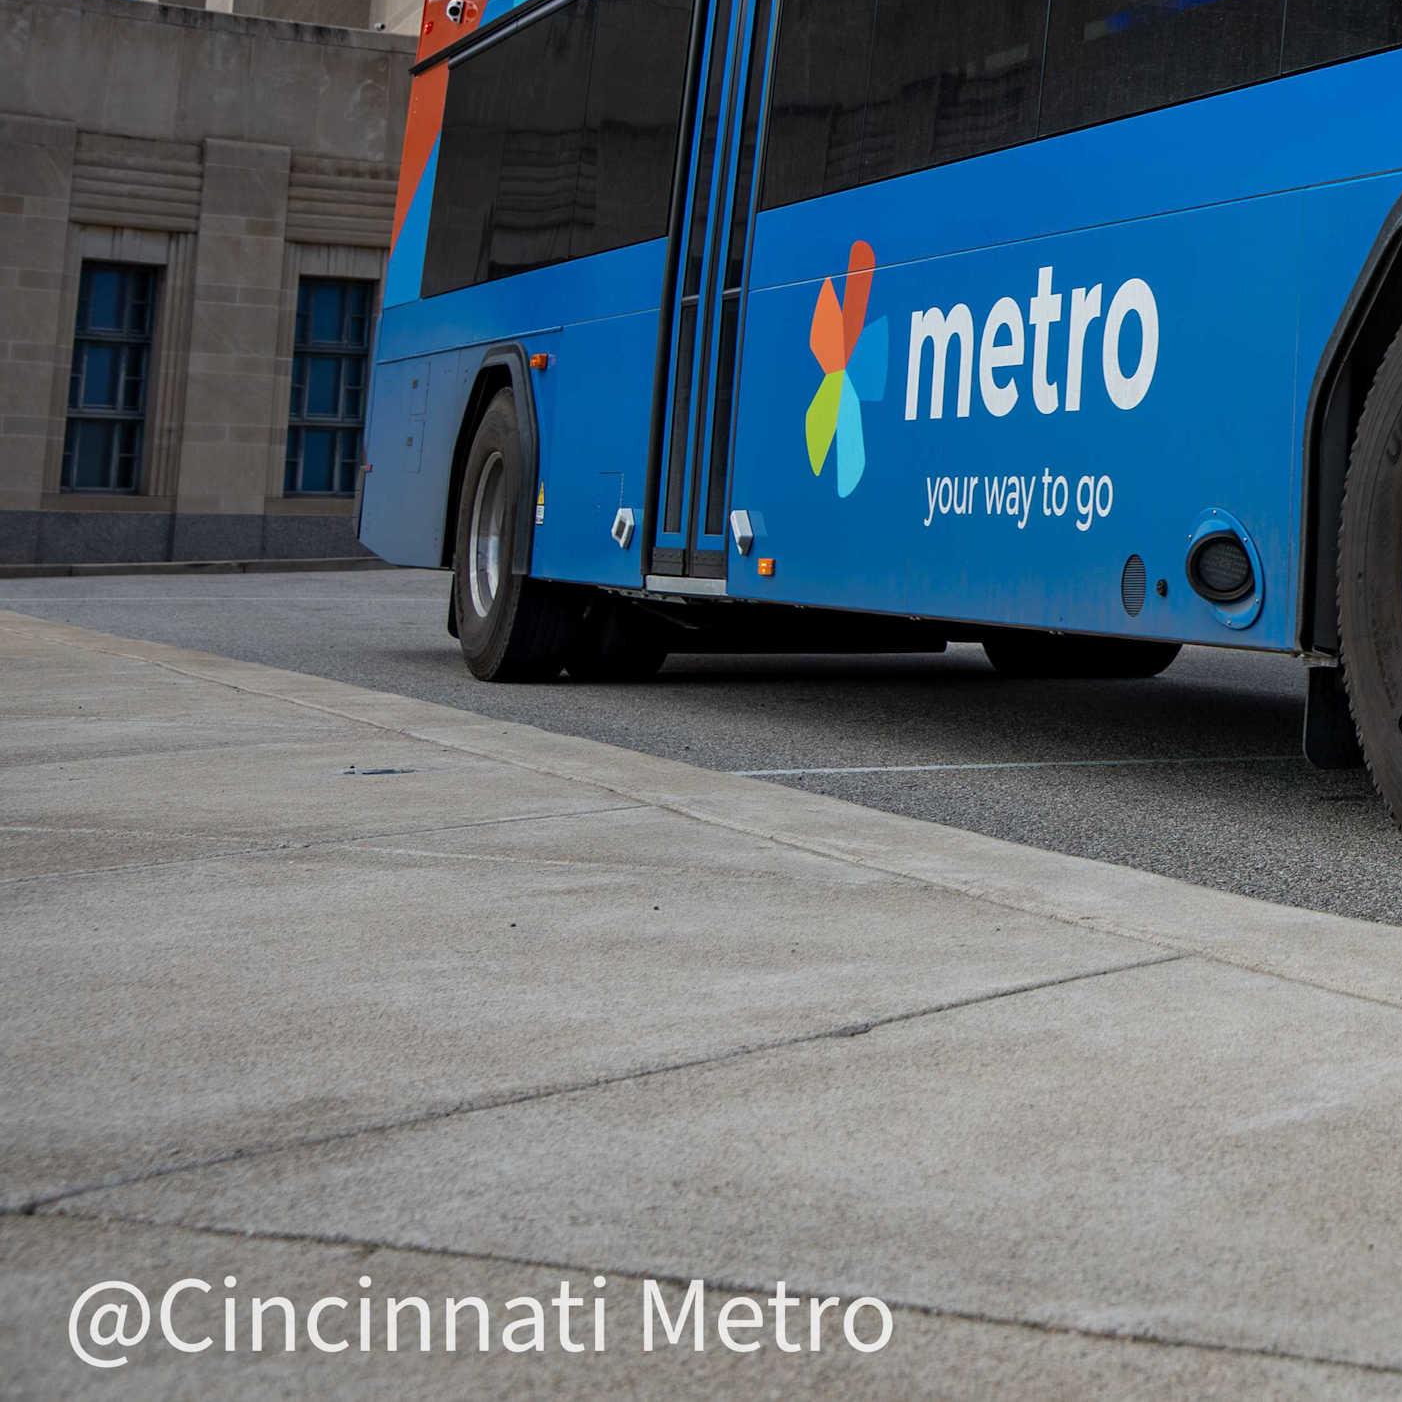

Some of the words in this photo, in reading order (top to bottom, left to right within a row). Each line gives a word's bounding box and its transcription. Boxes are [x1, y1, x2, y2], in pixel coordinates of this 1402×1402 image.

[904, 266, 1159, 421] metro
[923, 476, 979, 528] your
[984, 476, 1037, 531] way
[1042, 467, 1069, 517] to
[1076, 475, 1114, 532] go
